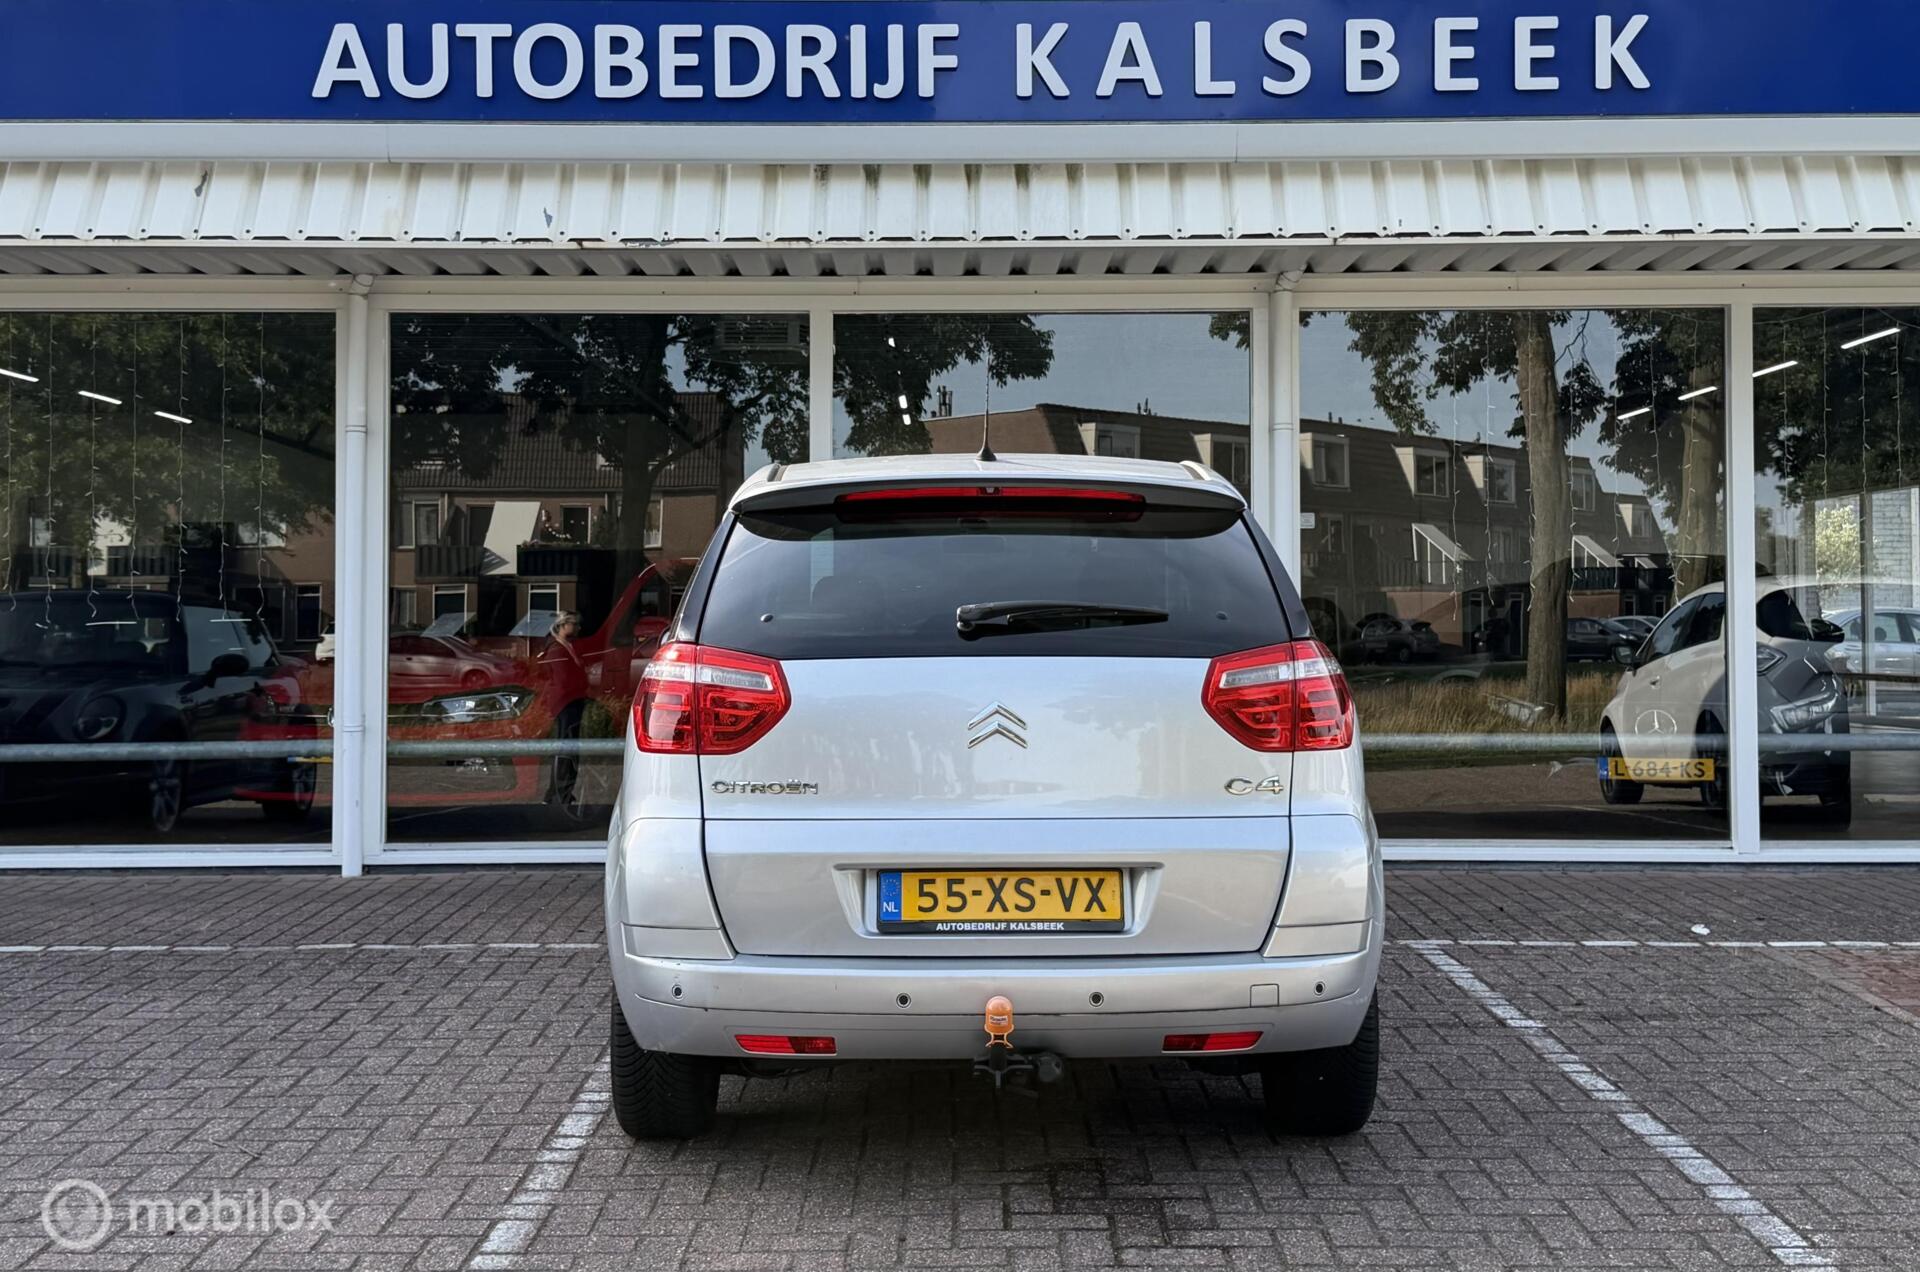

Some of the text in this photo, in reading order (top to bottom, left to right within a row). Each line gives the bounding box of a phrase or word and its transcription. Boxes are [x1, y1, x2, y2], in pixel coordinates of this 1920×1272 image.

[311, 14, 1651, 100] AUTOBEDRIJF KALSBEEK
[1613, 760, 1706, 778] L-684-KS
[711, 779, 819, 795] CITROËN
[1224, 775, 1284, 795] C4
[882, 901, 899, 913] NL
[917, 877, 1107, 913] 55-XS-VX
[935, 921, 1065, 932] AUTOBEDRIJF KALSBEEK
